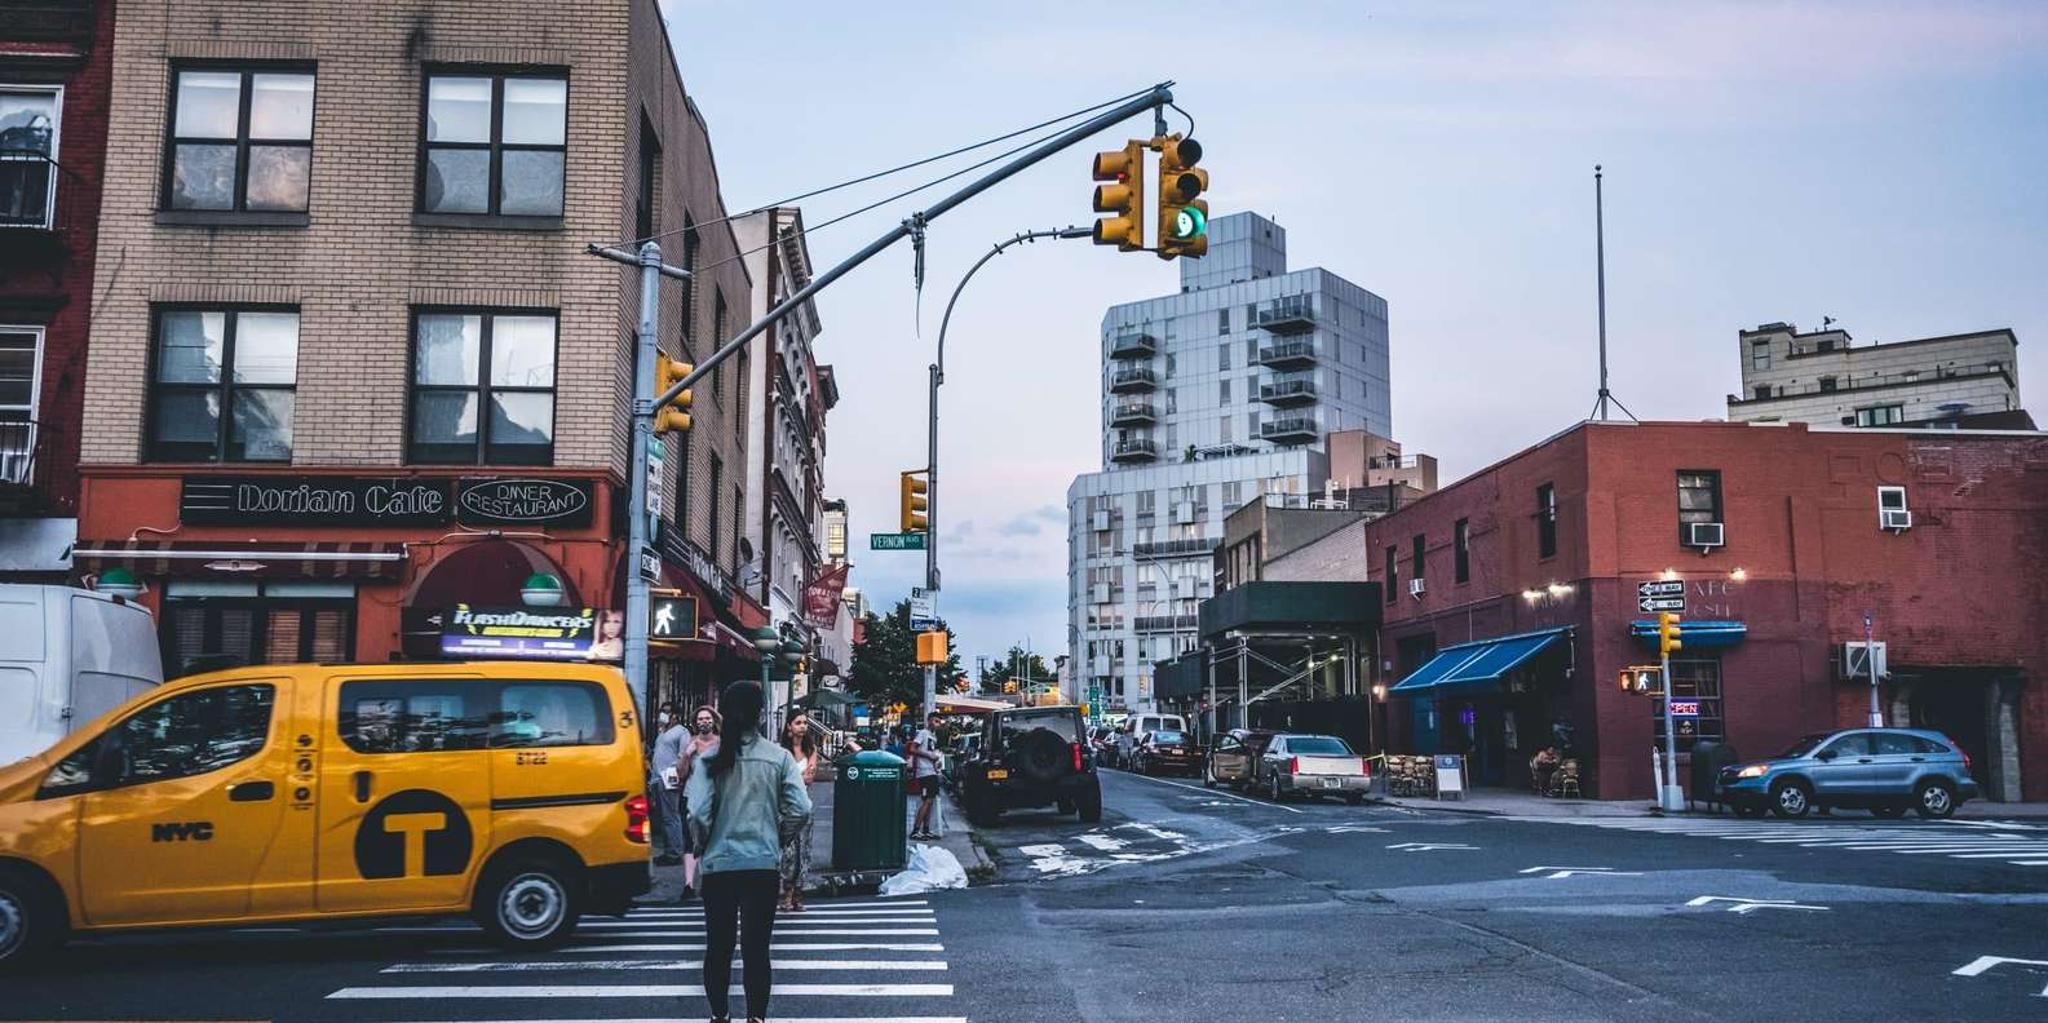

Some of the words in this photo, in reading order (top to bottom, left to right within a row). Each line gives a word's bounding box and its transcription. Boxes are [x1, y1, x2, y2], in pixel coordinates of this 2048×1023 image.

[238, 484, 355, 514] Dorian
[365, 485, 444, 515] Cafe
[497, 485, 551, 500] DINER
[467, 490, 579, 516] RESTAURANT
[872, 535, 905, 548] VERNON
[152, 822, 214, 842] NYC
